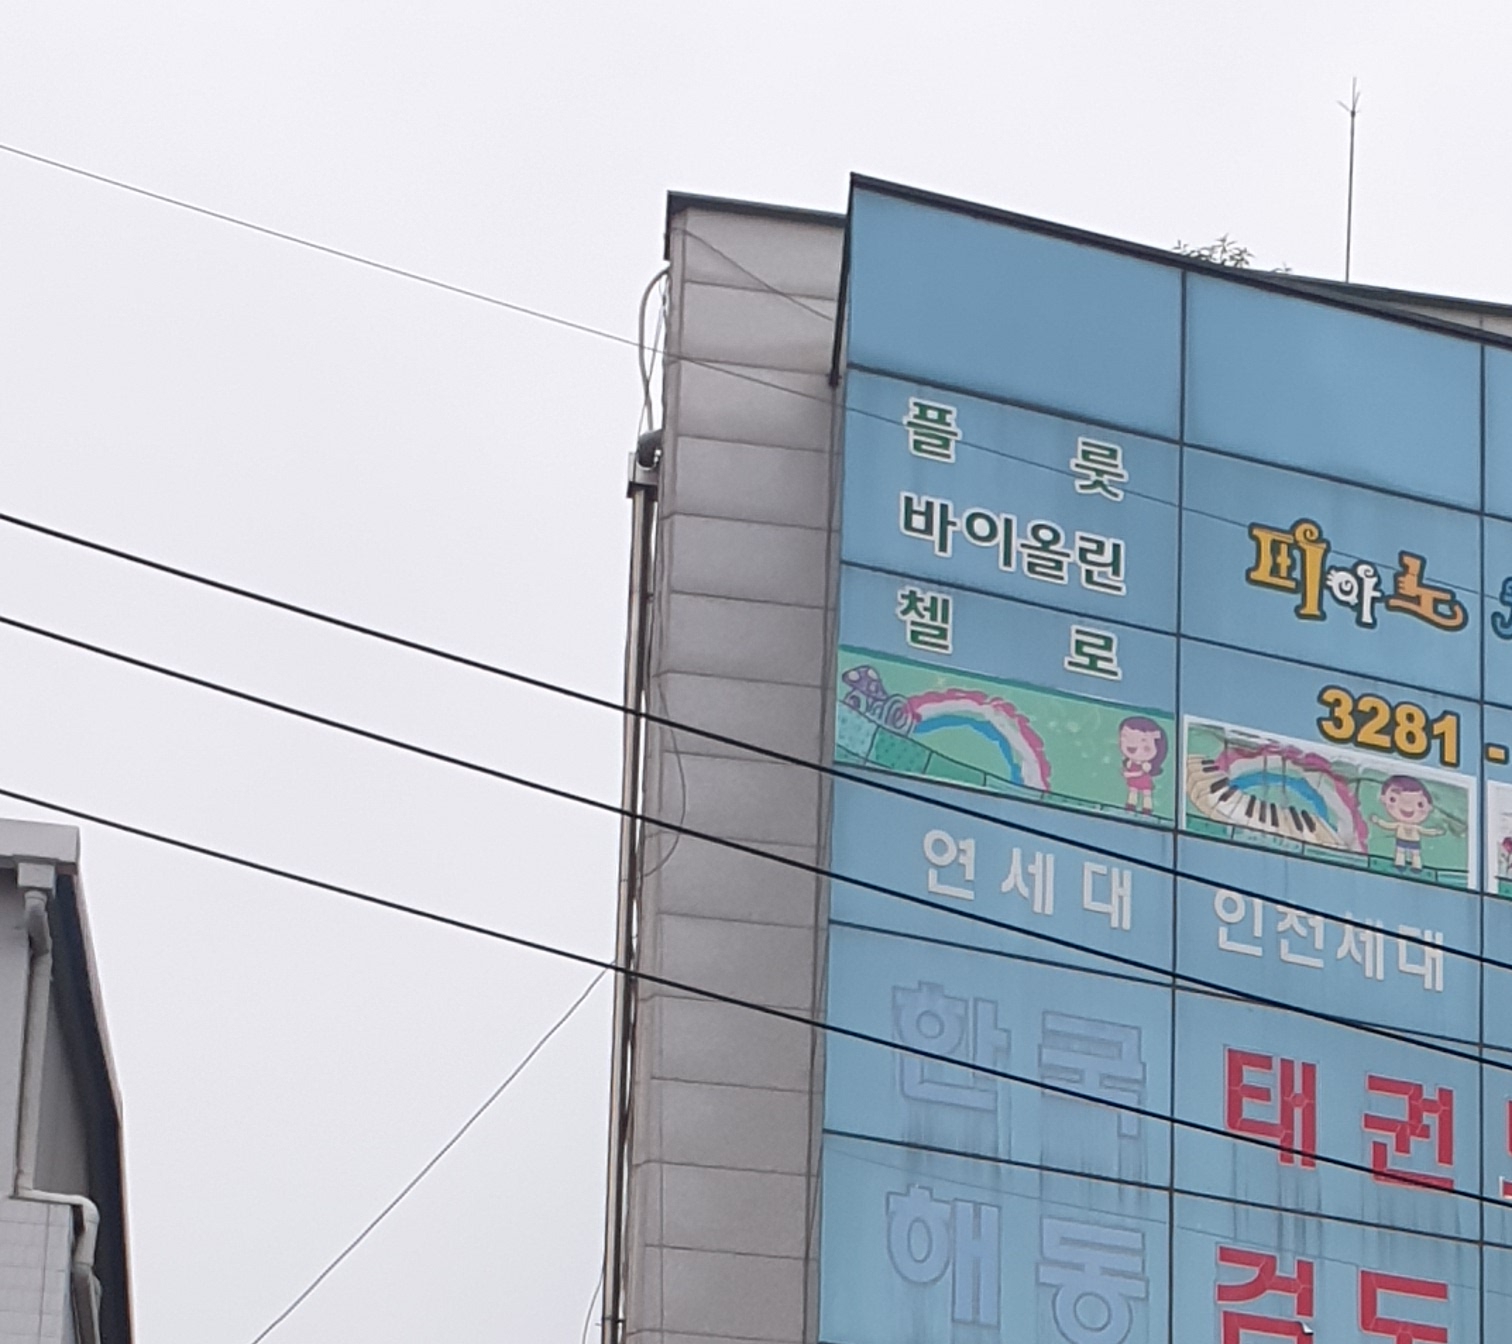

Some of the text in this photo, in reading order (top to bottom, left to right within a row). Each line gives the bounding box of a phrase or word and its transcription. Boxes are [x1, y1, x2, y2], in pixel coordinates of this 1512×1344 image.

[900, 491, 1127, 597] 바이올린
[1247, 518, 1467, 632] 피아노
[923, 829, 1134, 931] 연세대
[890, 980, 1146, 1140] 한국
